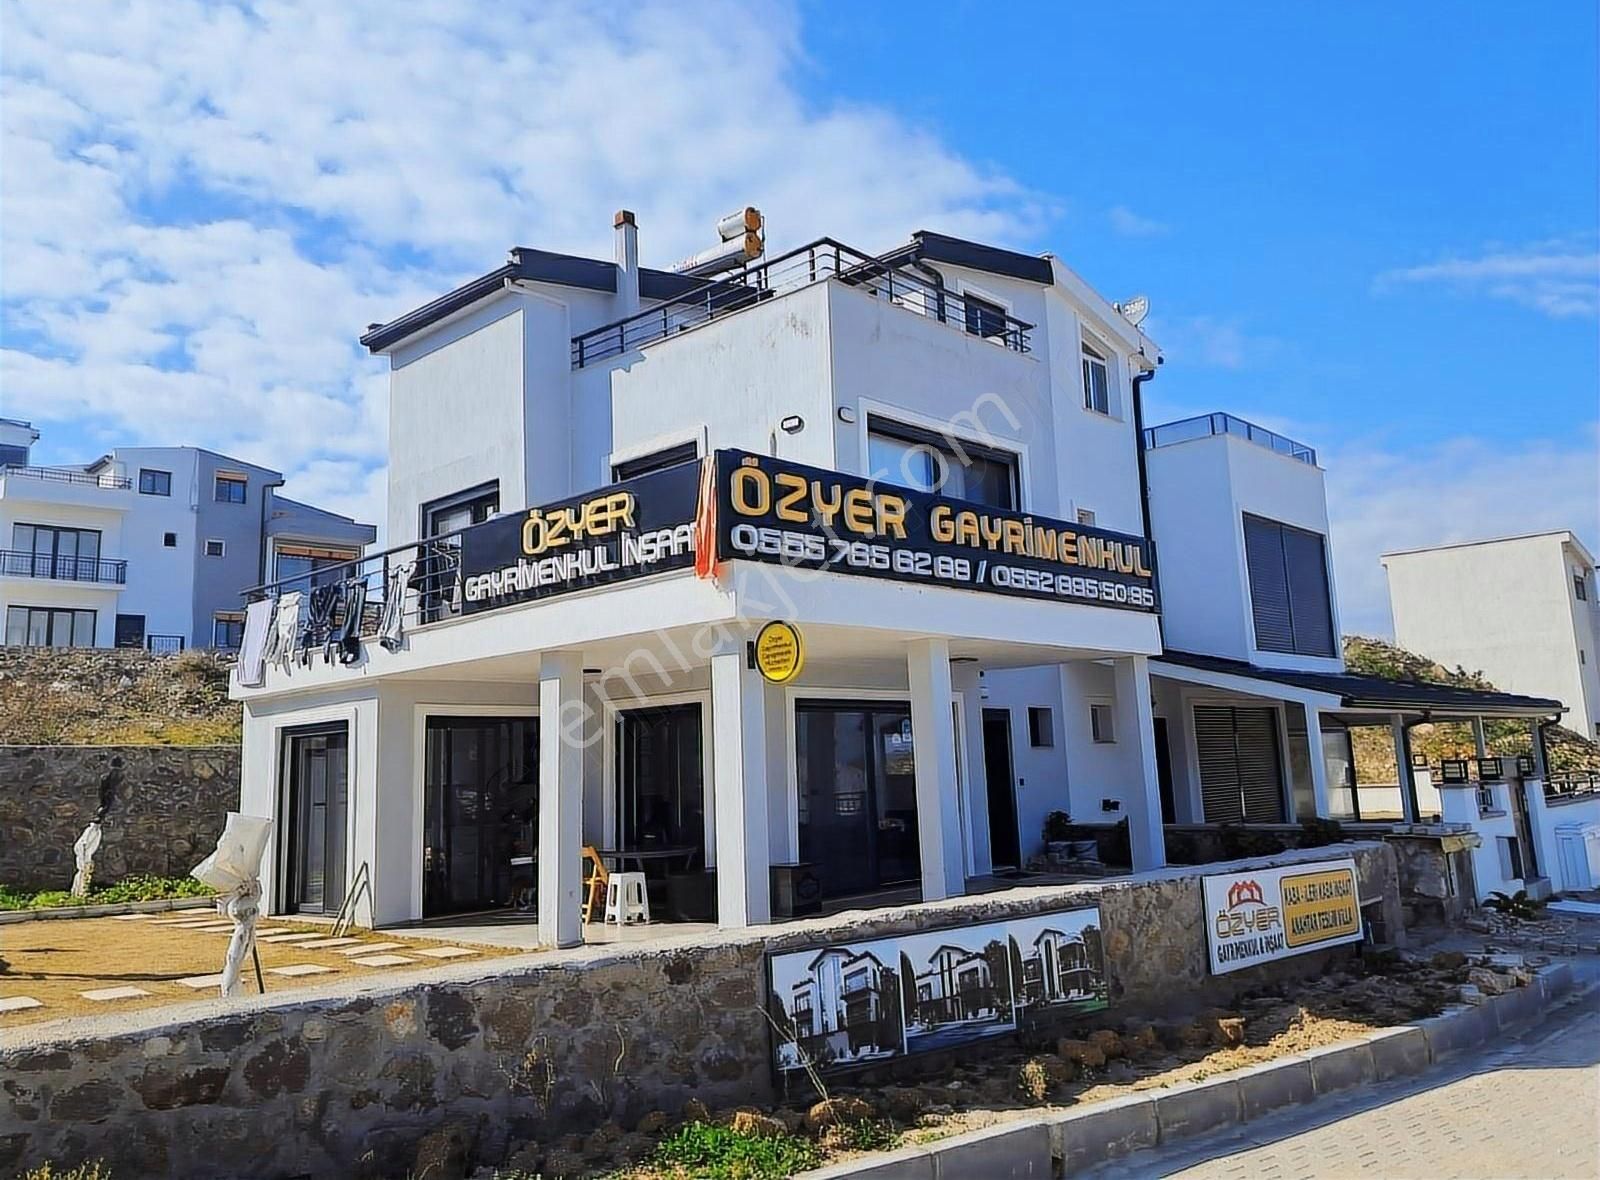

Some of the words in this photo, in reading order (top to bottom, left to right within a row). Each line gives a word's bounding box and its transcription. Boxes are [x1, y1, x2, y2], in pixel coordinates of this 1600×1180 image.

[521, 490, 635, 555] ÖZYER
[731, 457, 907, 540] ÖZYER
[930, 505, 1152, 577] GAYRİMENKUL
[465, 545, 619, 601] GAYRİMENKUL
[991, 565, 1055, 593] 0552
[1215, 906, 1282, 939] ÖZYER
